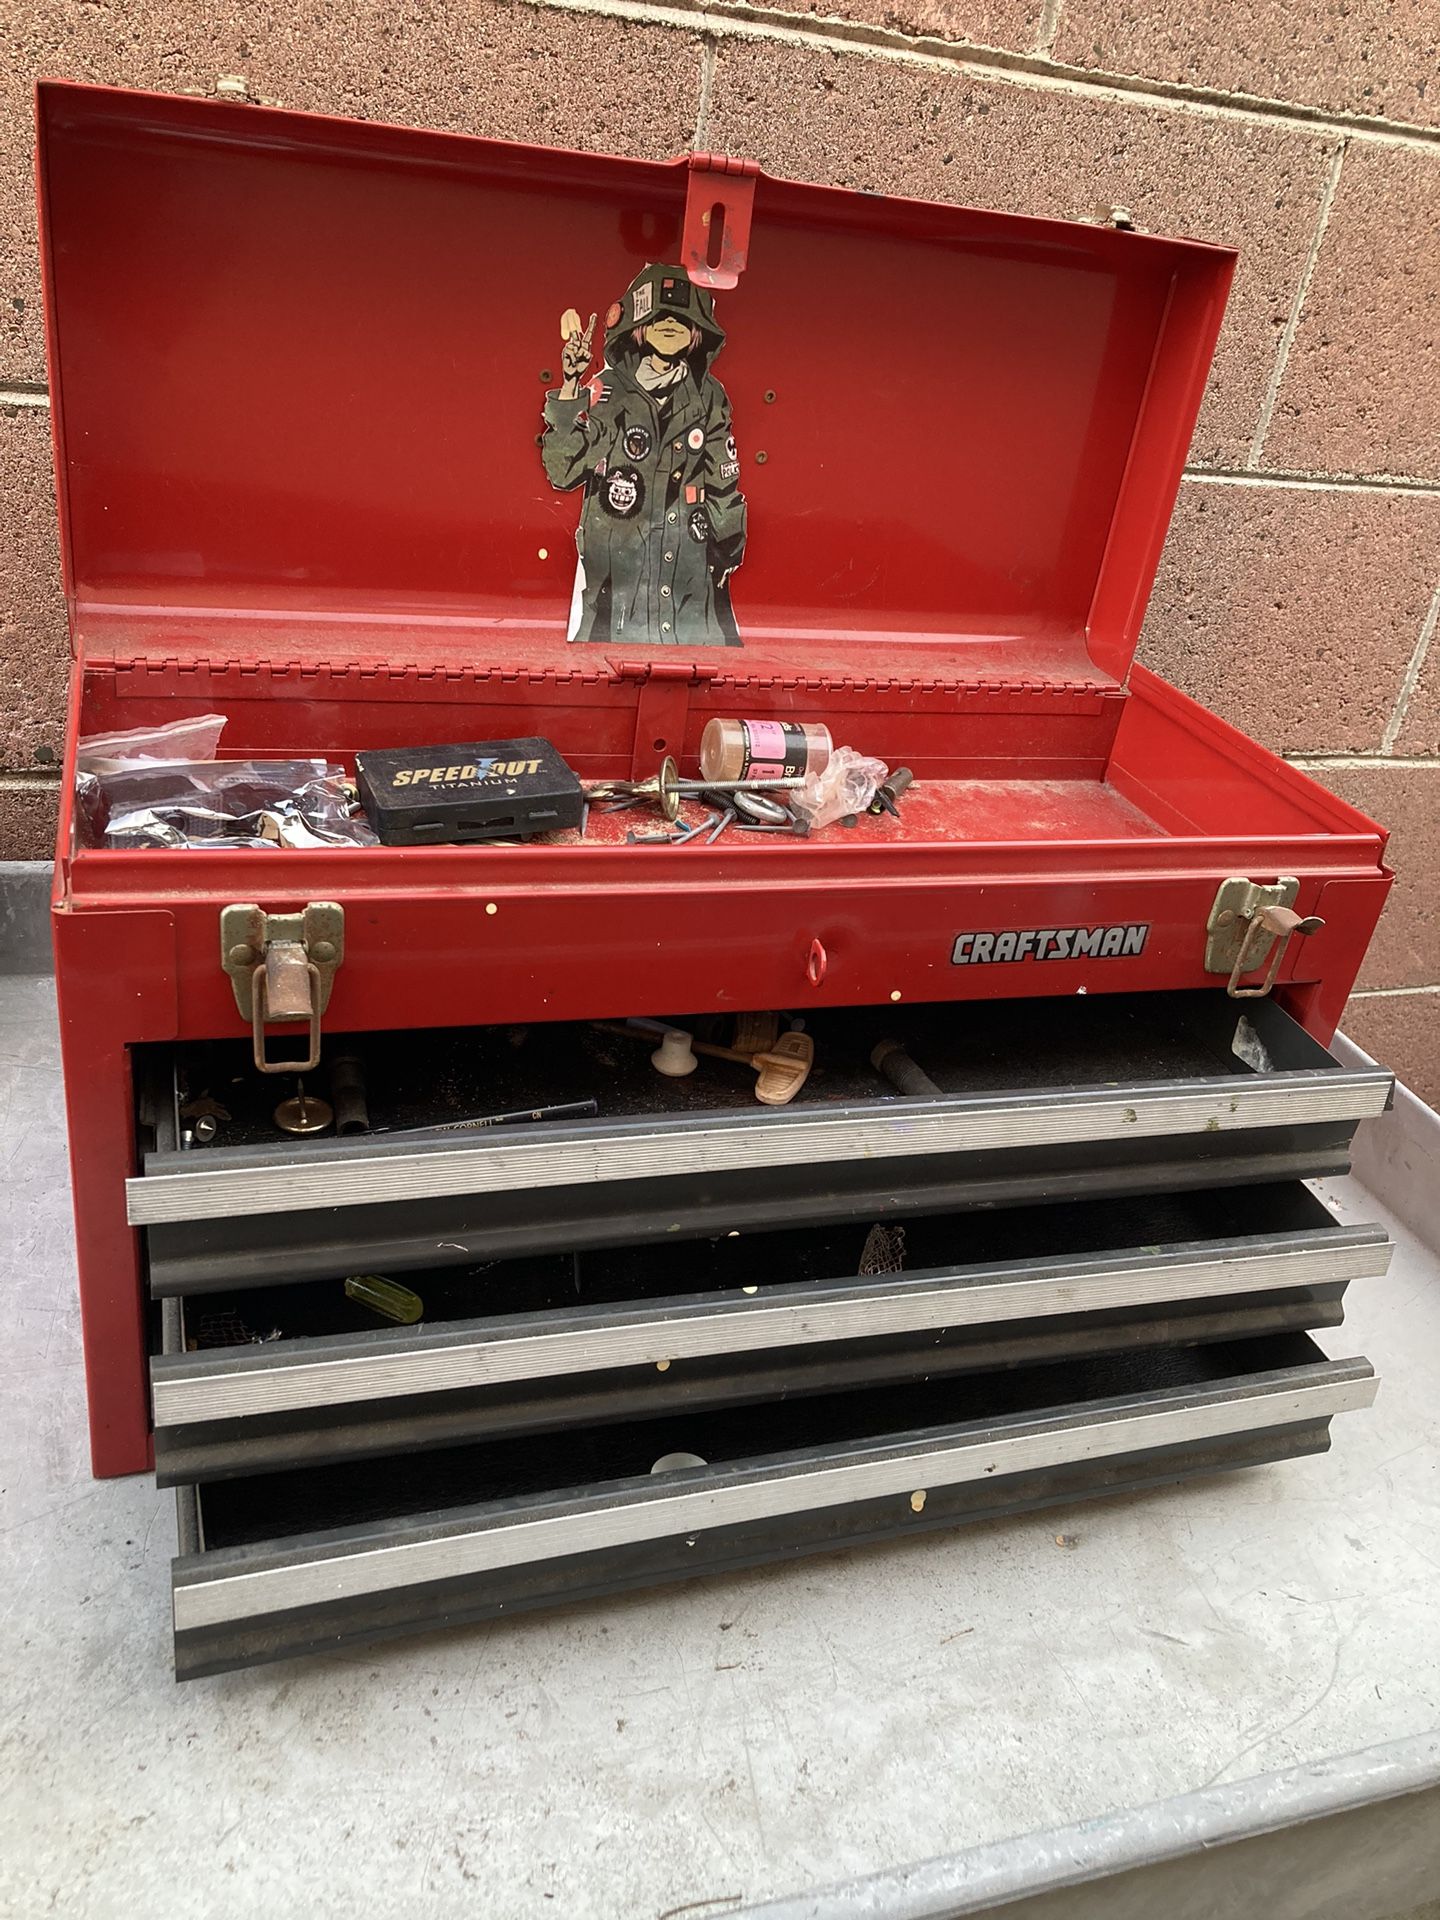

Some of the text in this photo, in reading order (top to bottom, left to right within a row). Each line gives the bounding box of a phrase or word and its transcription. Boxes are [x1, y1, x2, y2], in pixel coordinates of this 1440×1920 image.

[635, 288, 645, 298] THE
[635, 296, 650, 318] FALL
[392, 764, 477, 787] SPEED
[428, 778, 518, 791] TITANIUM
[951, 924, 1150, 966] CRAFTSMAN
